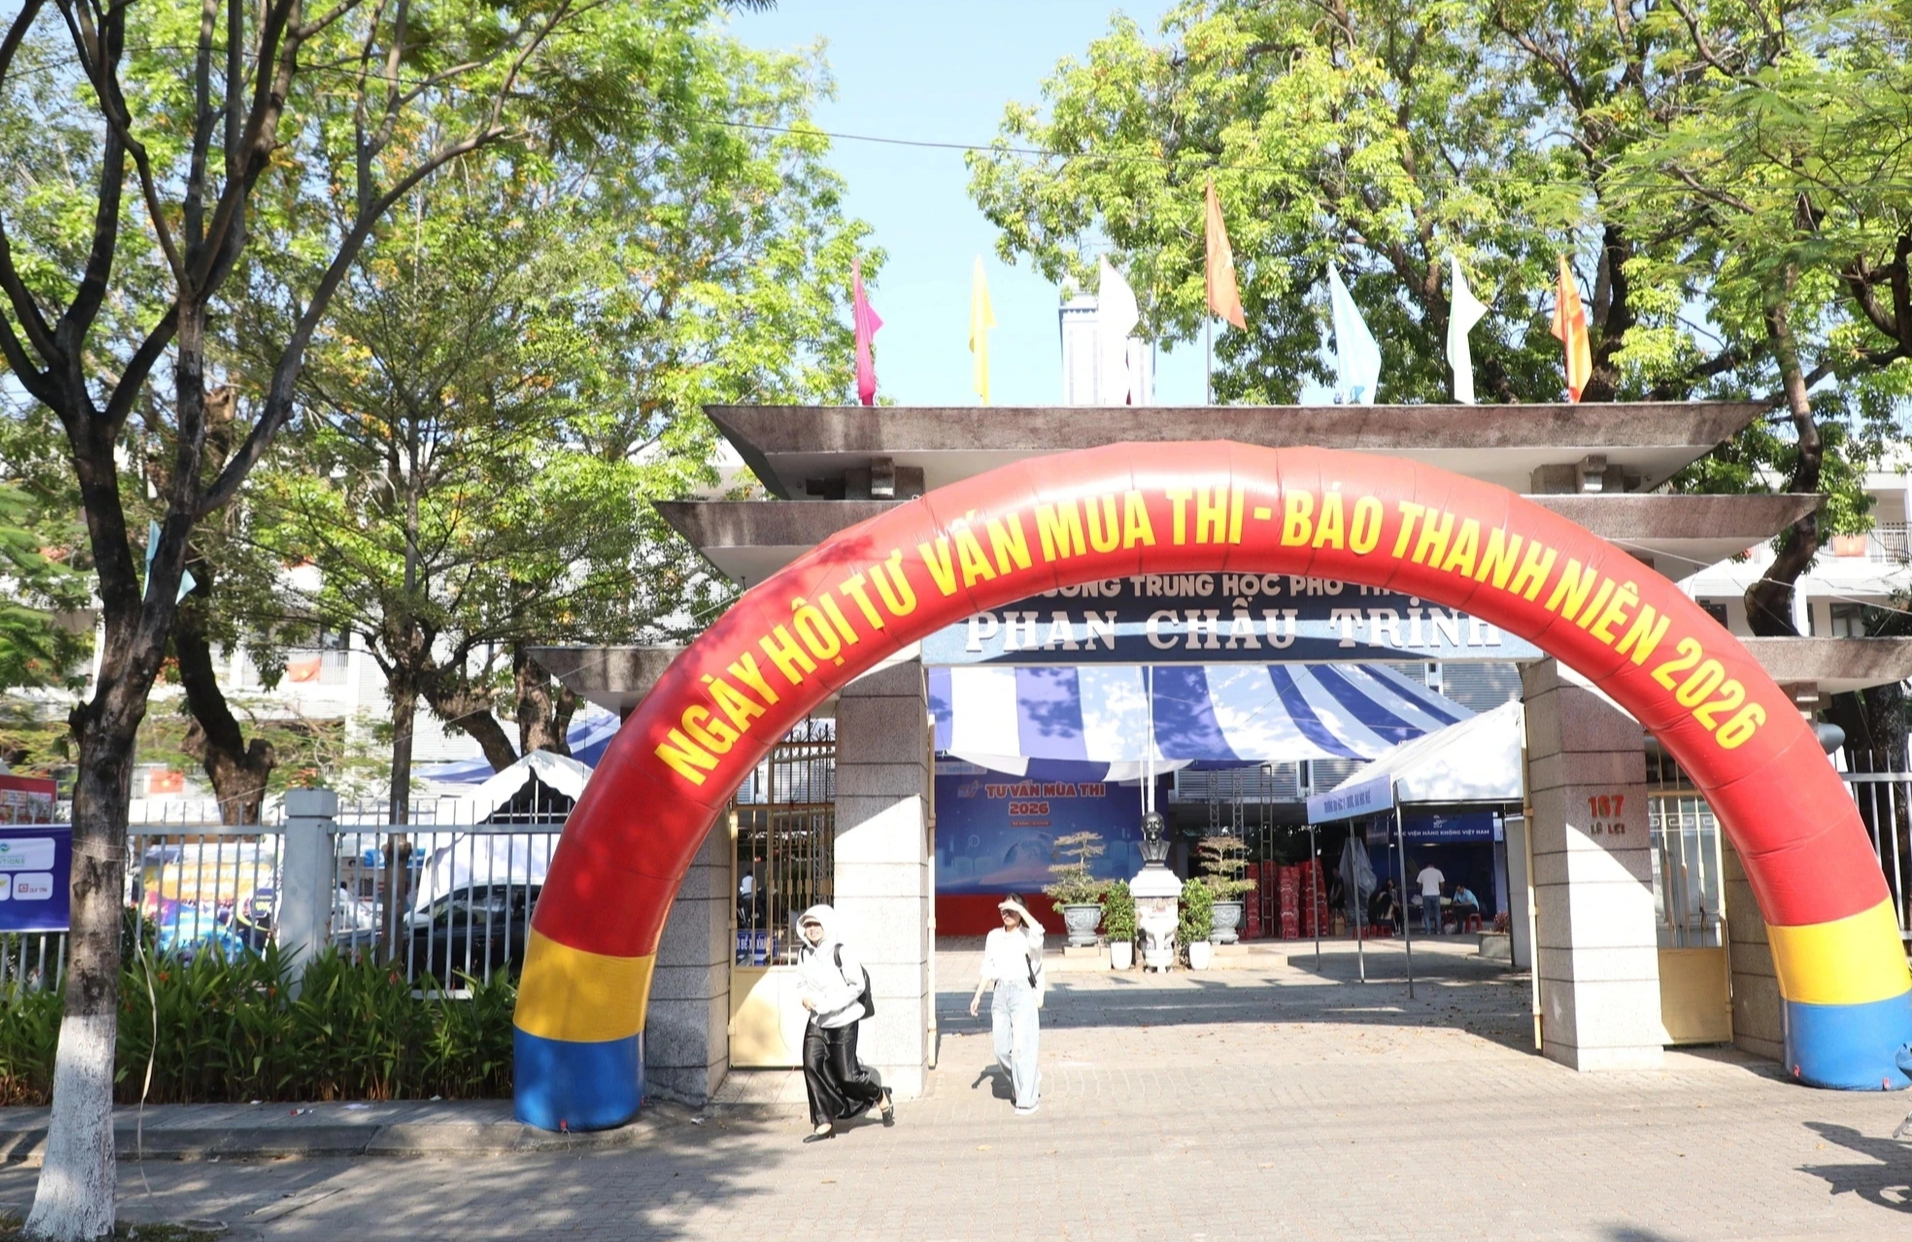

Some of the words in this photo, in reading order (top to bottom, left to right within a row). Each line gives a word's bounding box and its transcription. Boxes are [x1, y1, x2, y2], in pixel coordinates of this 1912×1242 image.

[1130, 574, 1214, 597] TRUNG
[1222, 574, 1281, 602] HỌC
[656, 651, 777, 786] NGÀY
[759, 592, 859, 684] HỘI
[838, 548, 917, 631] TƯ
[917, 509, 1033, 597] VẤN
[1164, 488, 1244, 545] THI
[1281, 480, 1385, 555] BÁO
[1391, 500, 1558, 601] THANH
[1543, 555, 1671, 666] NIÊN
[1650, 636, 1767, 750] 2026
[965, 610, 1118, 652] PHAN
[1145, 597, 1299, 650] CHÂU
[1329, 597, 1502, 649] TRINH
[1078, 783, 1106, 798] THI
[1008, 801, 1050, 816] 2026
